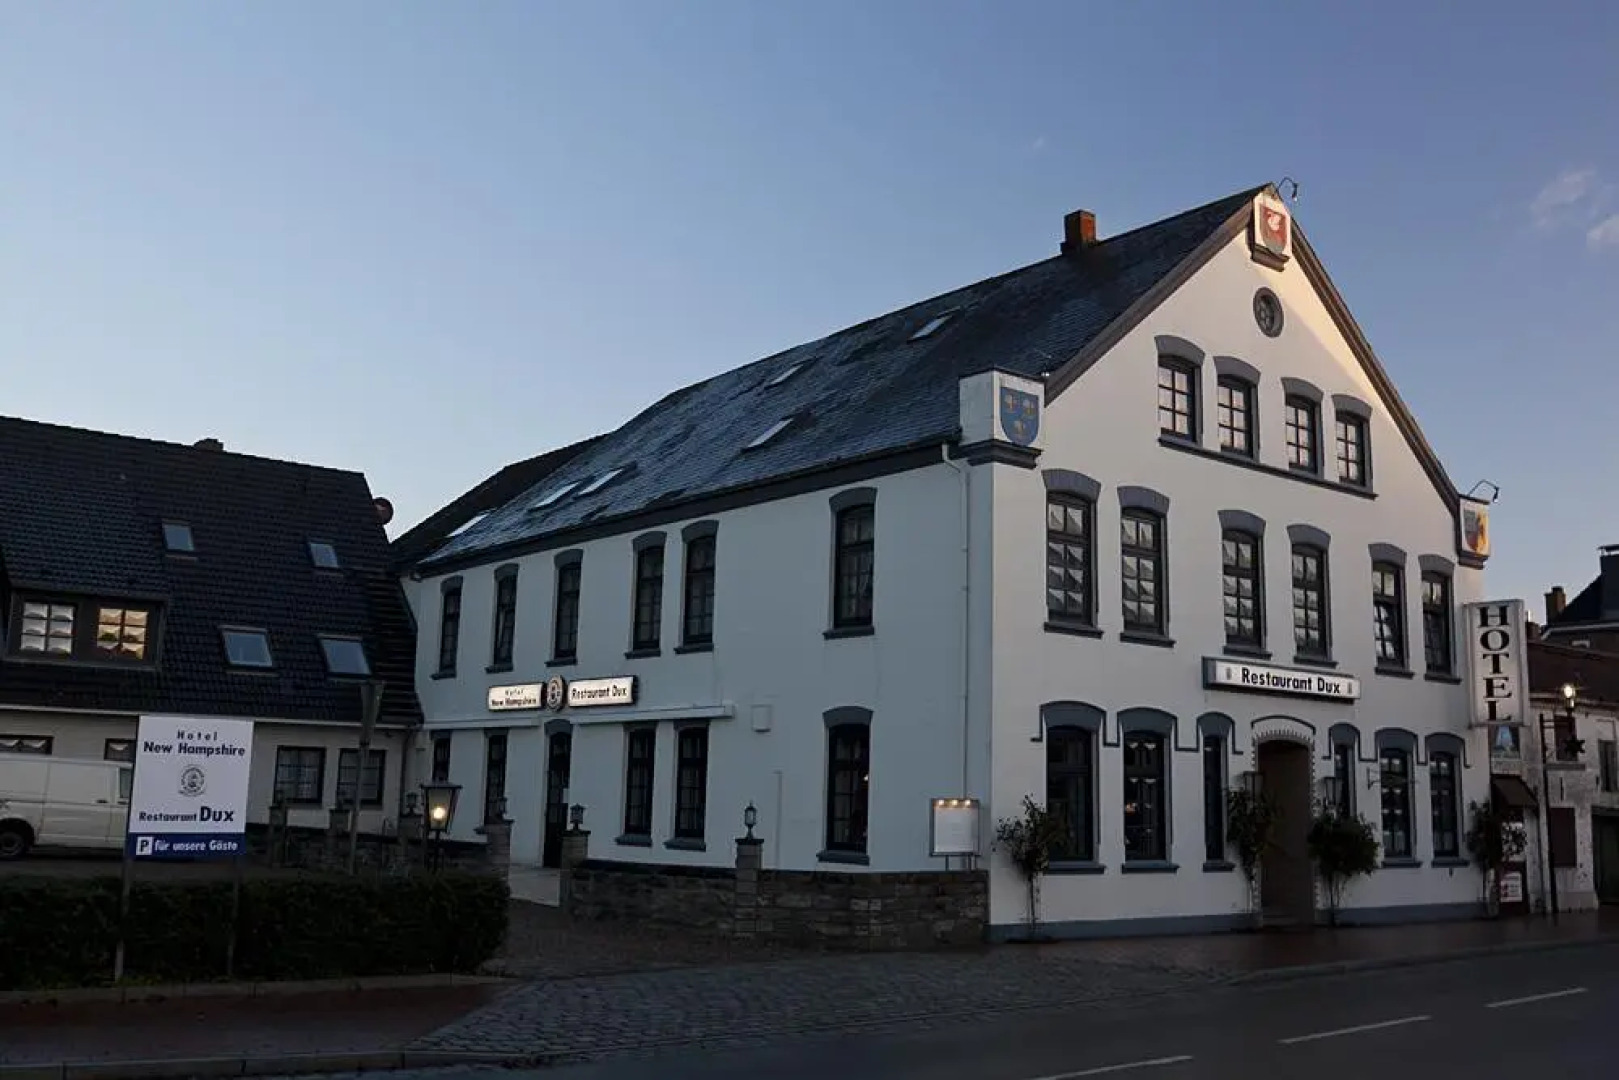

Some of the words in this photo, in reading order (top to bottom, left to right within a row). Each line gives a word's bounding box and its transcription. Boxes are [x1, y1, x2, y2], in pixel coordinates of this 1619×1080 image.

[1477, 605, 1512, 721] HOTEL
[1241, 667, 1312, 690] Restaurant
[1317, 677, 1341, 694] Dux
[571, 687, 610, 699] Restaurant
[612, 684, 627, 697] Dux
[177, 730, 218, 741] Hotel
[144, 741, 173, 753] New
[178, 743, 246, 757] Hampshire
[138, 811, 197, 822] Restaurant
[200, 806, 234, 822] Dux
[140, 839, 150, 852] P
[154, 840, 170, 851] für
[173, 841, 206, 851] unsere
[209, 840, 238, 851] Gäste
